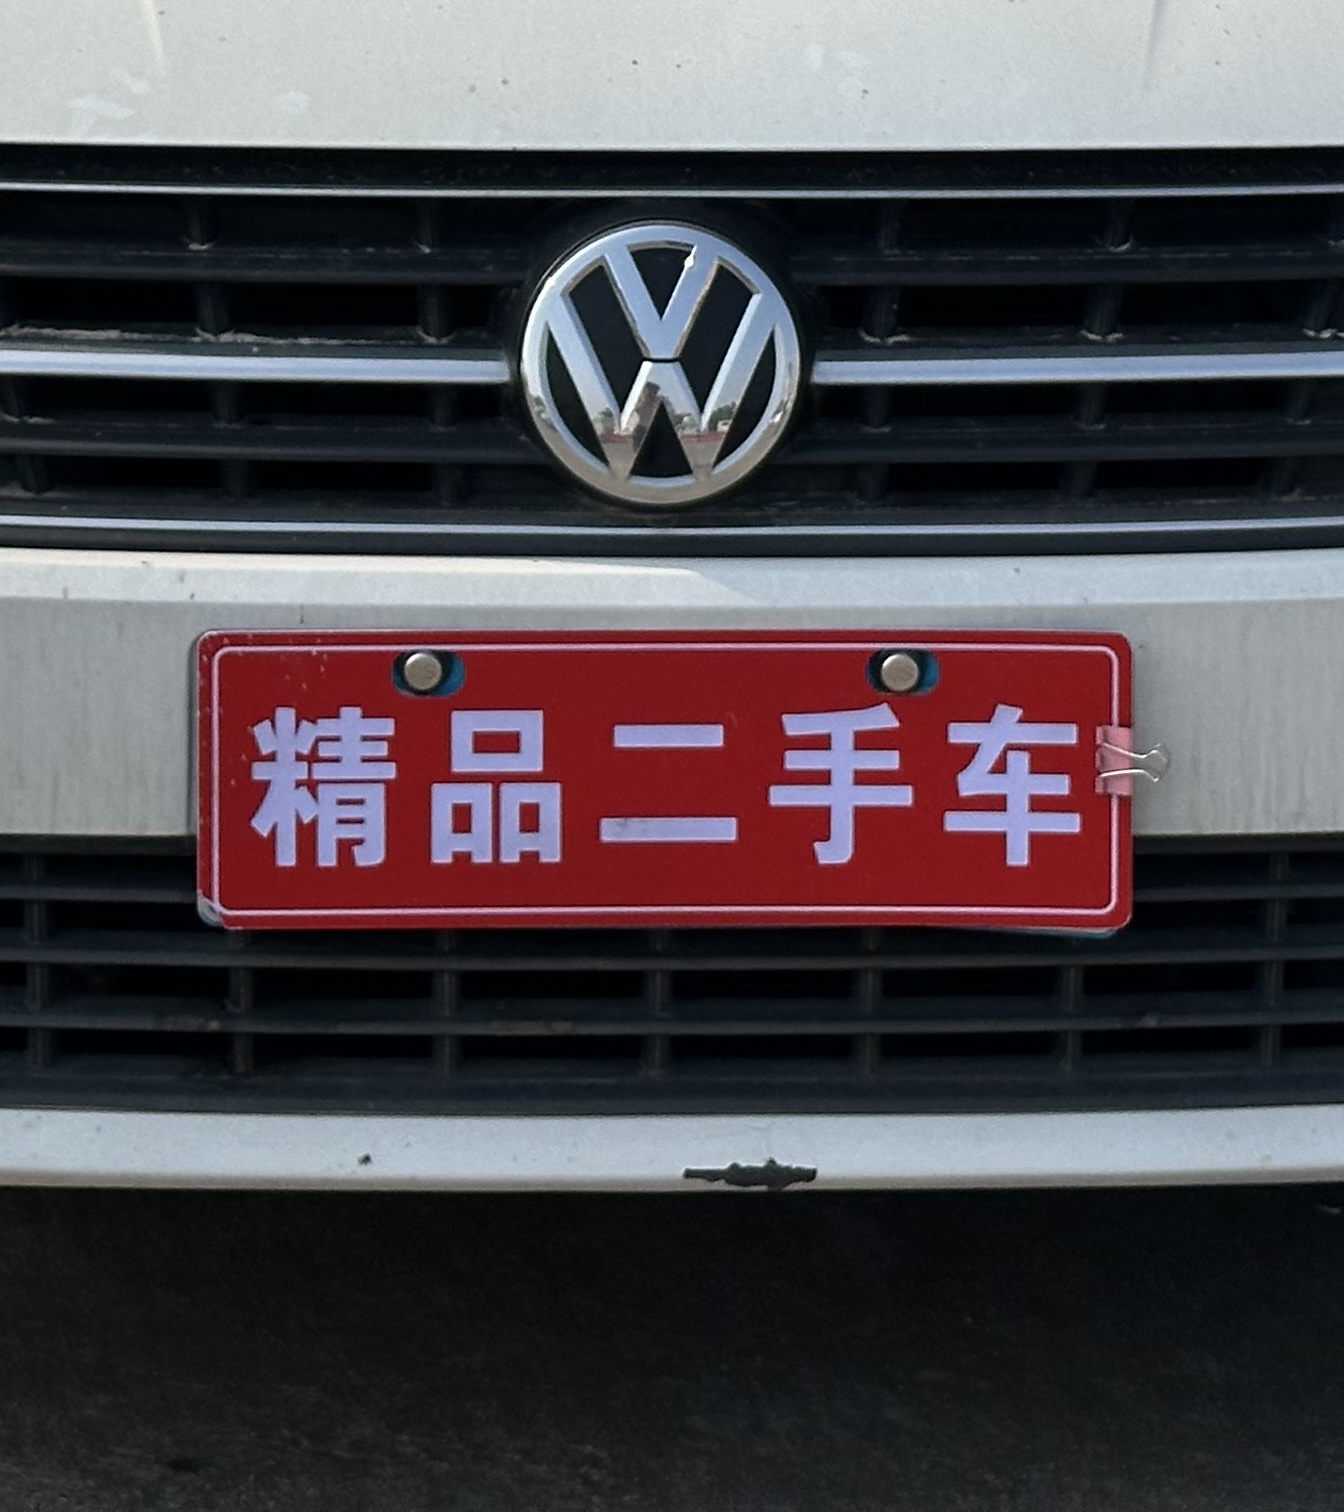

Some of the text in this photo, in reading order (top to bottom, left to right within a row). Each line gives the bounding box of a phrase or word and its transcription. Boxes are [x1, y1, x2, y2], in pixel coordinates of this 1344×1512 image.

[251, 702, 1082, 869] 精品二手车
